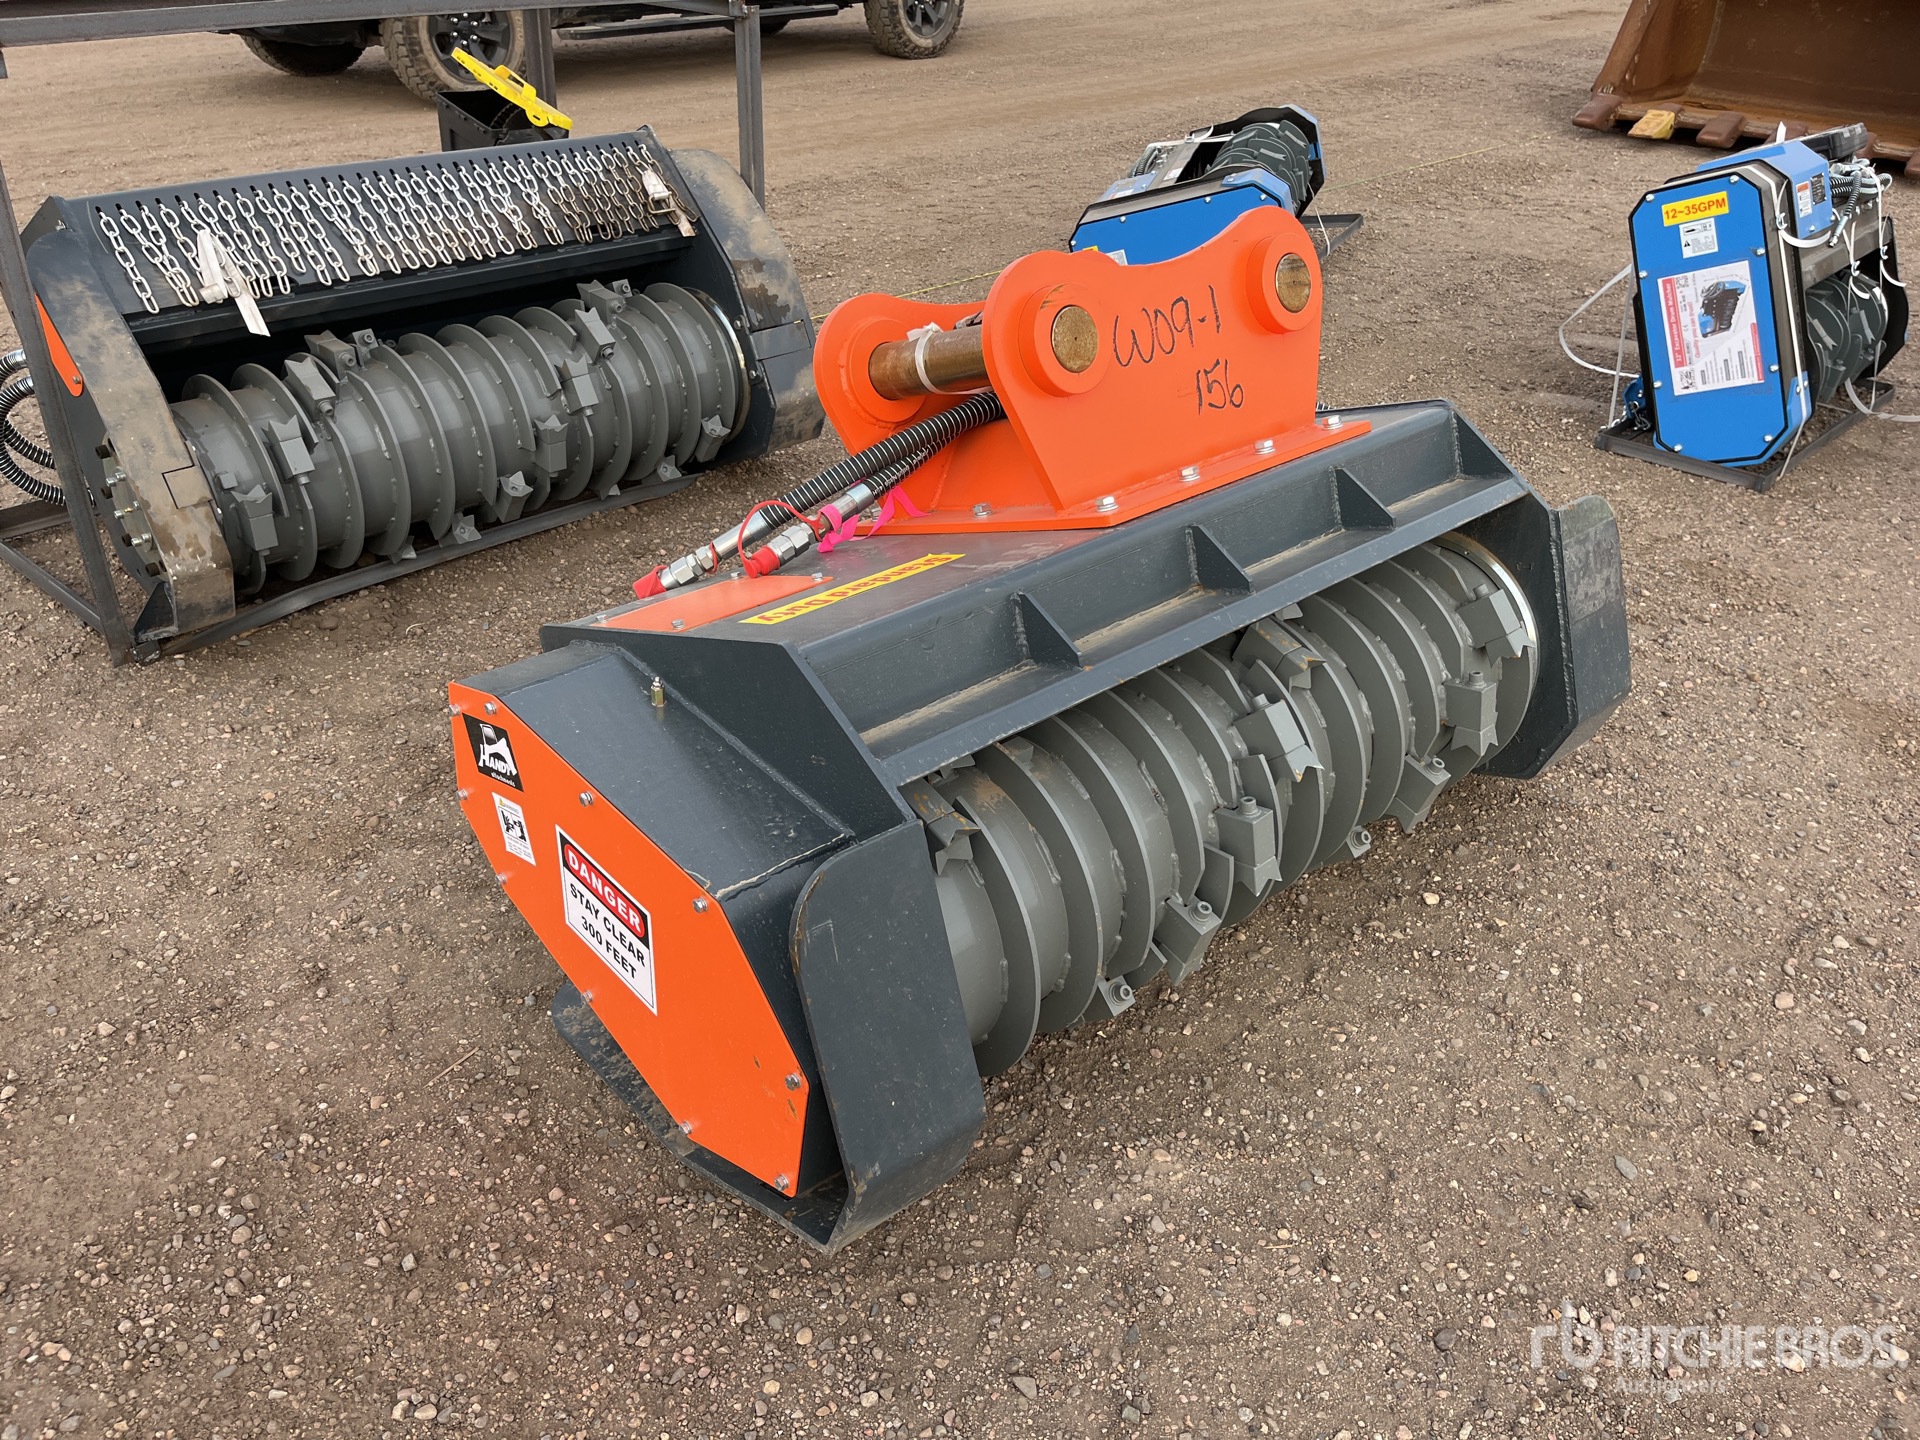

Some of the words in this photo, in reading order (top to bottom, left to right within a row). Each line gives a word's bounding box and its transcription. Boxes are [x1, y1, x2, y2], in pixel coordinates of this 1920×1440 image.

[1664, 197, 1726, 220] 12~35GPM
[1196, 358, 1244, 416] 156
[827, 556, 953, 598] Standard
[757, 598, 830, 622] Duty
[567, 848, 643, 933] DANGER
[570, 882, 600, 920] STAY
[603, 916, 646, 968] CLEAR
[581, 915, 603, 946] 300
[605, 939, 637, 979] FEET
